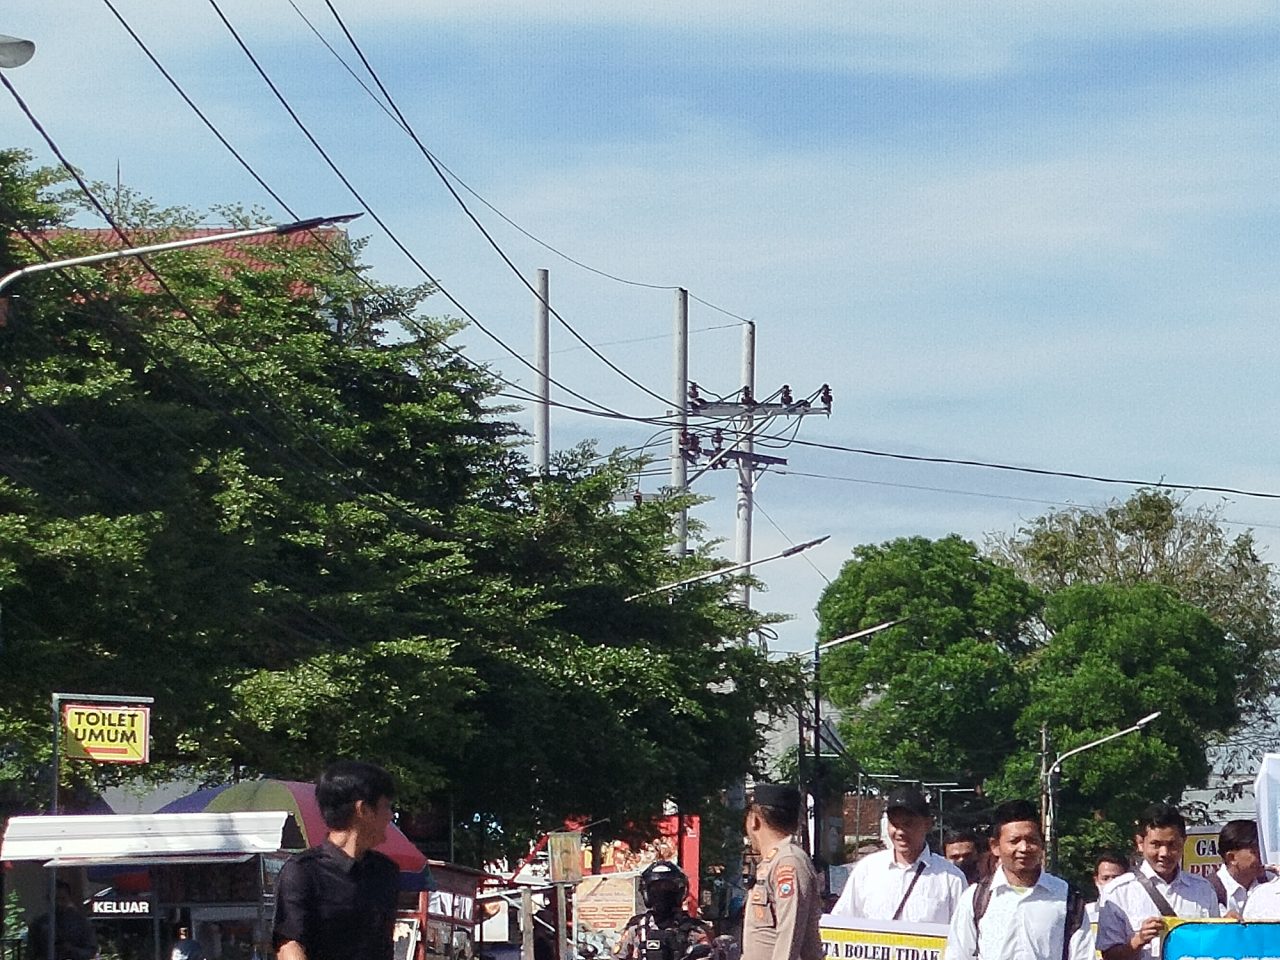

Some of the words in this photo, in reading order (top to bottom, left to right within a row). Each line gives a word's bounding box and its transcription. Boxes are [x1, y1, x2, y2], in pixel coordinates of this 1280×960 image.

[74, 711, 138, 727] TOILET
[74, 728, 137, 743] UMUM
[93, 901, 149, 913] KELUAR
[845, 943, 890, 960] BOLEH
